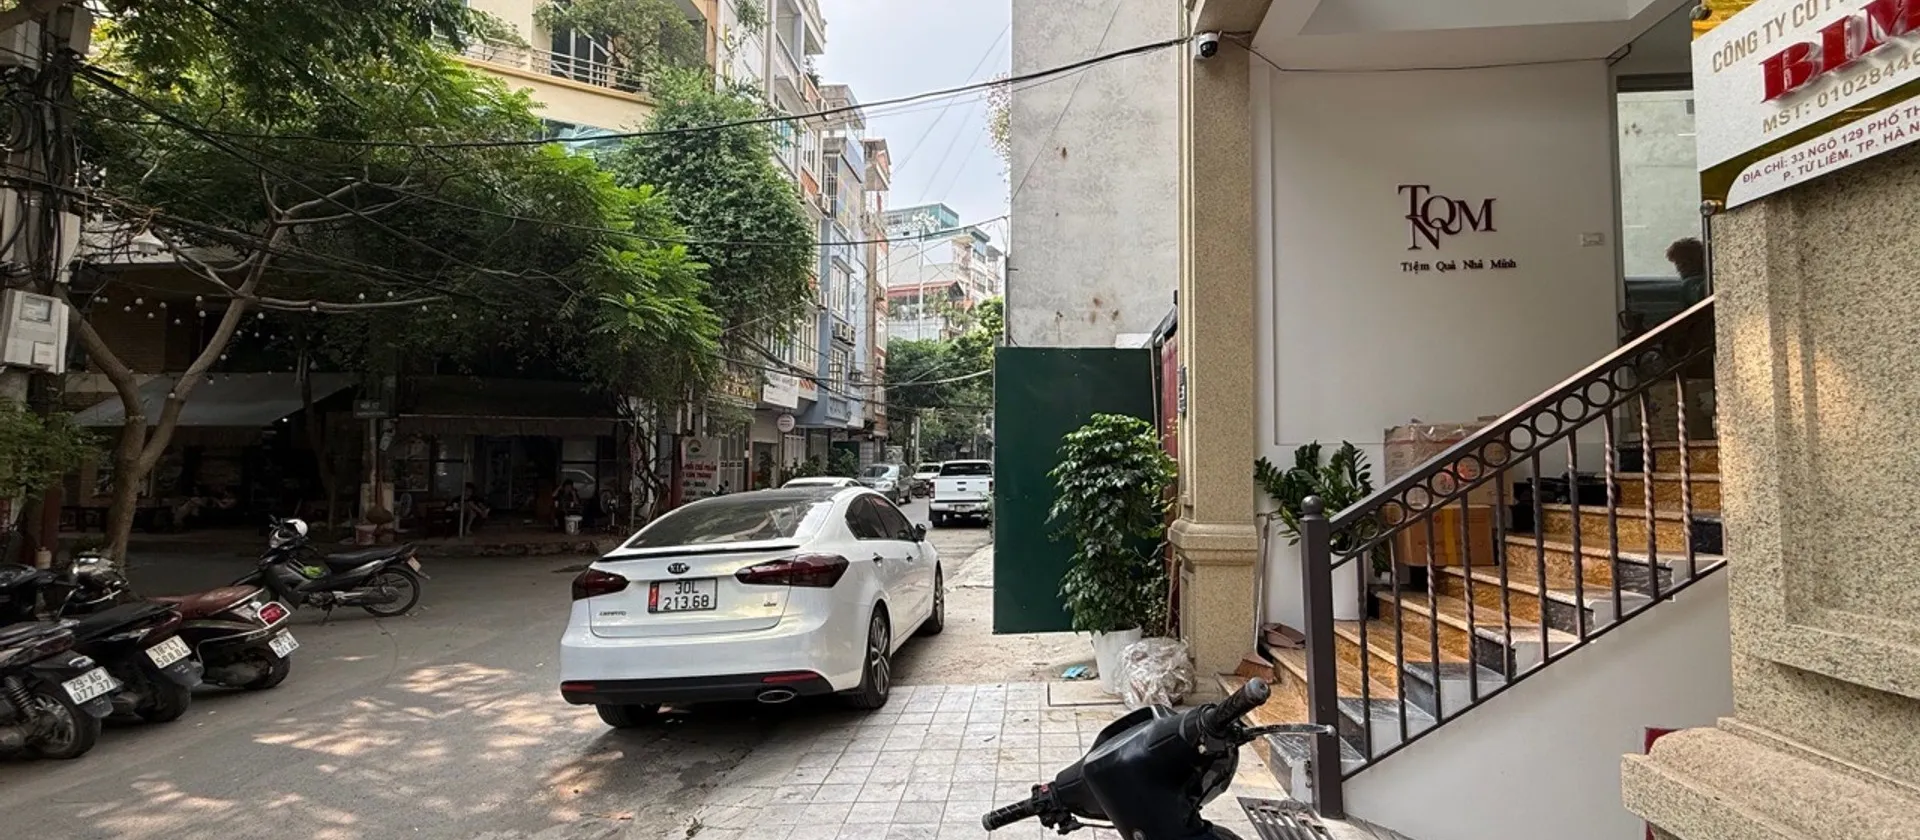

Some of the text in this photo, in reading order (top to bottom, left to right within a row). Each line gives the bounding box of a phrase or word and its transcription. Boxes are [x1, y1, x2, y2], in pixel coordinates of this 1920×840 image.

[1712, 29, 1758, 73] CÔNG
[1762, 12, 1787, 45] TY
[1763, 103, 1811, 133] MST:
[1743, 169, 1762, 183] ĐỊA
[1791, 152, 1805, 164] 33
[1842, 128, 1864, 144] 129
[1867, 109, 1900, 134] PHỐ
[1783, 171, 1795, 181] P.
[1857, 139, 1879, 153] TP.
[1883, 126, 1905, 143] HÀ
[1400, 260, 1430, 275] Tiệm
[663, 594, 710, 610] 213.68
[674, 581, 699, 595] 30L
